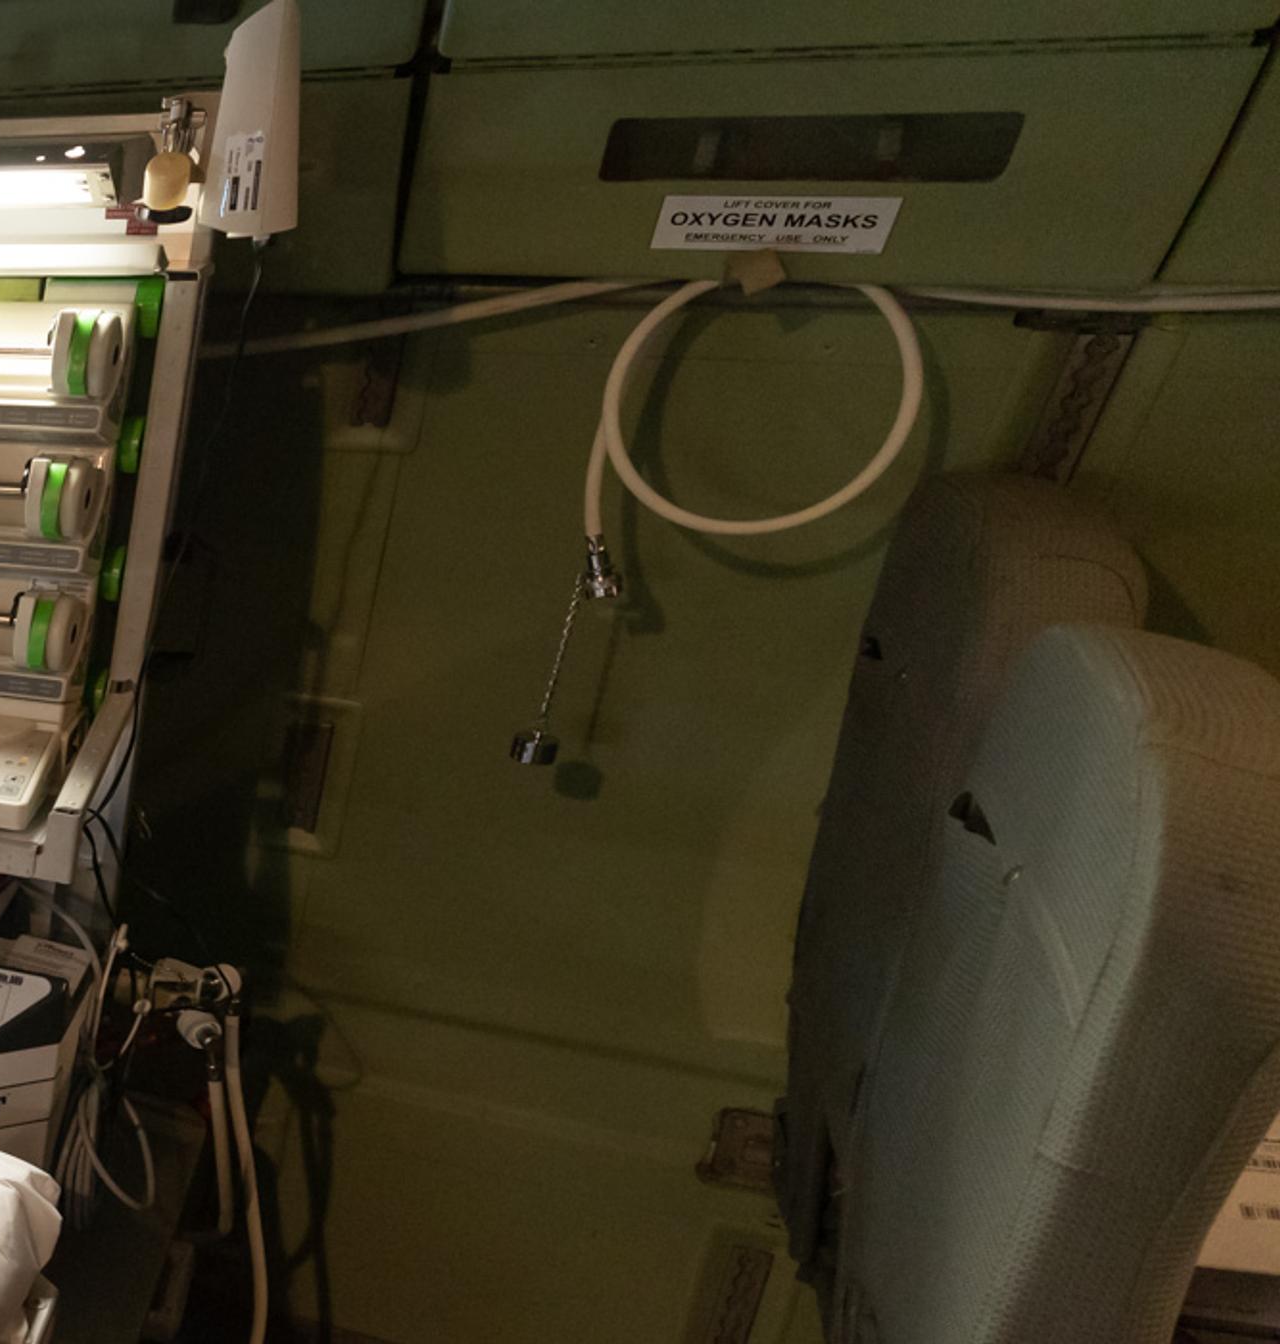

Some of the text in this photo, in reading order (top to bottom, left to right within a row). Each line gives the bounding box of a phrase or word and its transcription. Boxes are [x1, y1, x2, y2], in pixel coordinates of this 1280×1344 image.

[723, 200, 833, 209] LIFT COVER FOR
[670, 211, 879, 229] OXYGEN MASKS
[684, 232, 850, 244] EMERGENCY USE ONLY
